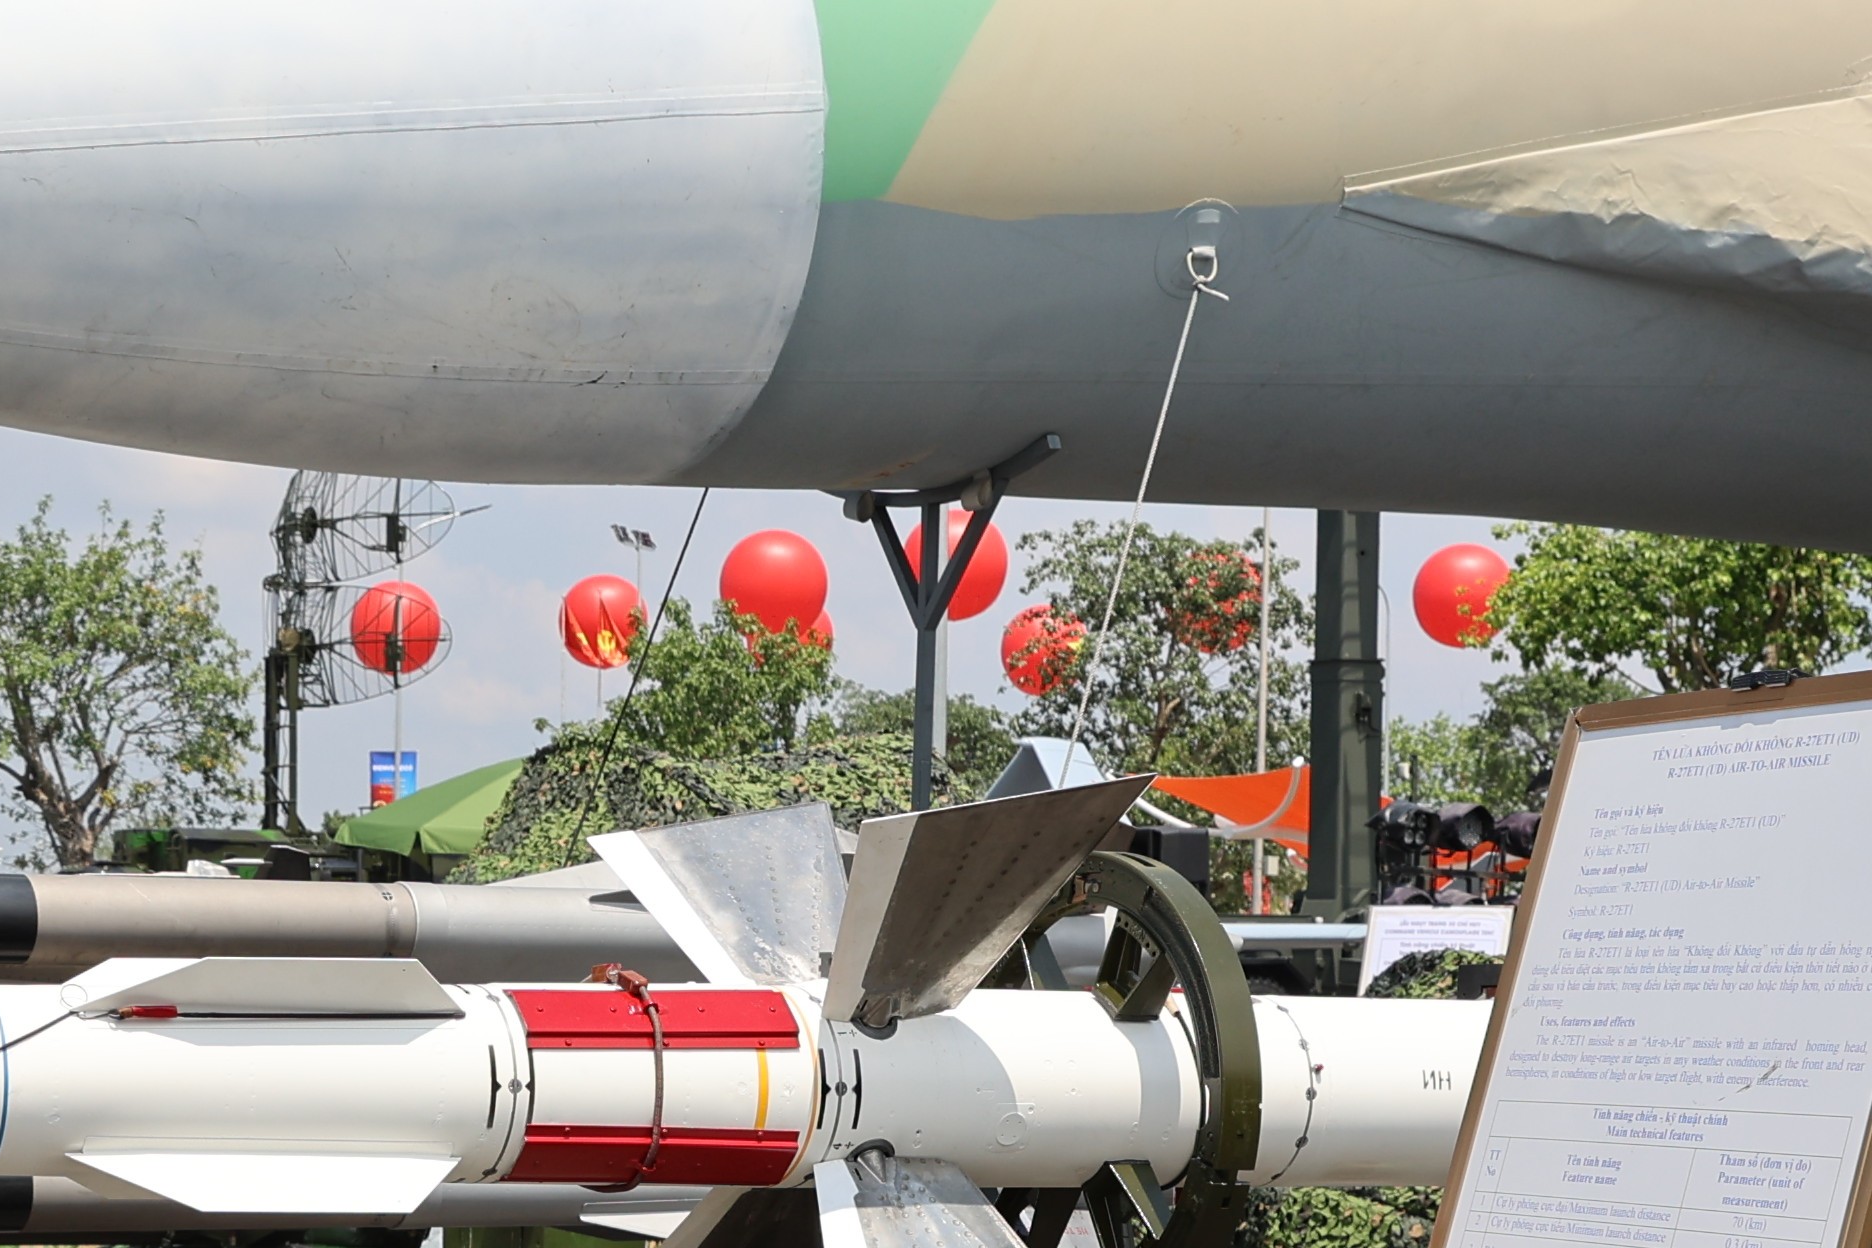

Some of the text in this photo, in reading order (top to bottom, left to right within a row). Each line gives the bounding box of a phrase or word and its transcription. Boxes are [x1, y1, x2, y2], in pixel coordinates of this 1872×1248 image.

[1728, 758, 1785, 774] AIR-TO-AIR
[1788, 754, 1831, 768] MISSILE
[1593, 1017, 1608, 1027] and
[1610, 1016, 1636, 1027] effects
[1727, 1038, 1744, 1050] with
[1748, 1039, 1758, 1050] an
[1806, 1039, 1840, 1055] homing
[1692, 1055, 1724, 1066] weather
[1727, 1056, 1771, 1068] conditions
[1785, 1058, 1799, 1069] the
[1802, 1057, 1824, 1070] front
[1826, 1059, 1844, 1070] and
[1846, 1061, 1866, 1071] rear
[1607, 1126, 1703, 1142] Main technical features
[1562, 1171, 1617, 1186] Feature name
[1718, 1172, 1805, 1190] Parameter (unit of
[1722, 1195, 1788, 1212] measurement)
[1745, 1218, 1767, 1233] (km)
